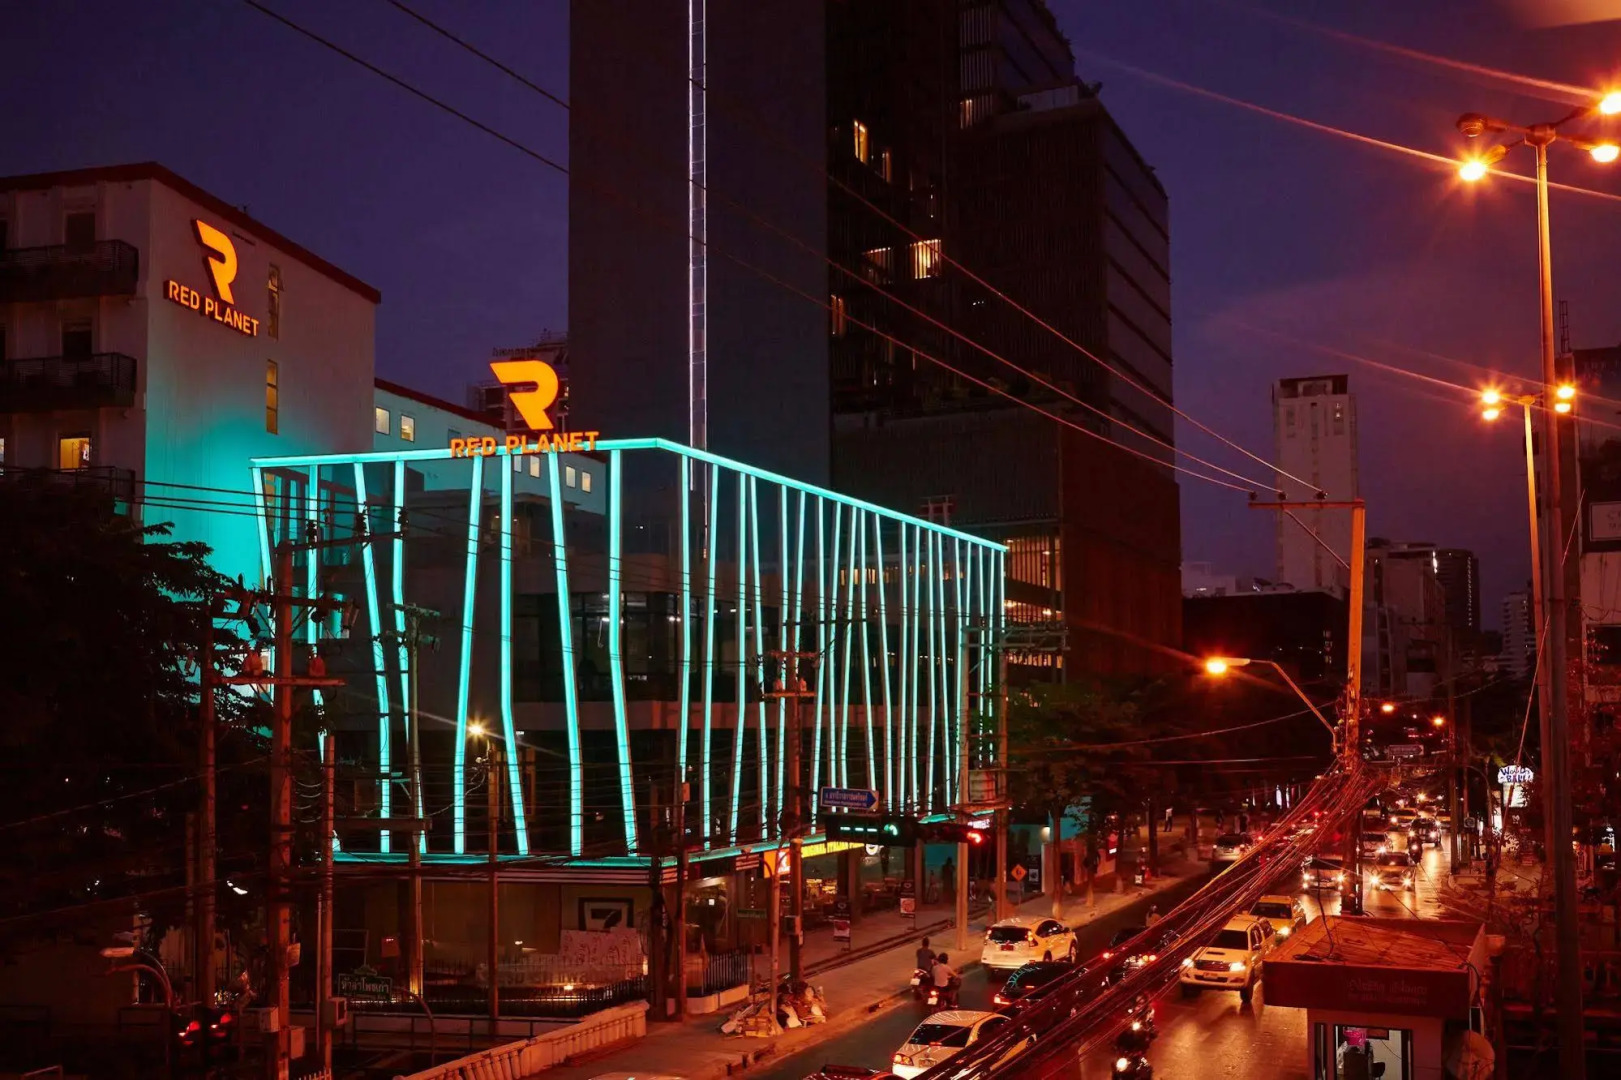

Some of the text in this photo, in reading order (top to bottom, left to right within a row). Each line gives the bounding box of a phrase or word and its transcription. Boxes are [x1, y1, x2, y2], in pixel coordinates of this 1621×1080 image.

[168, 280, 260, 337] RED PLANET
[450, 431, 600, 457] RED PLANET
